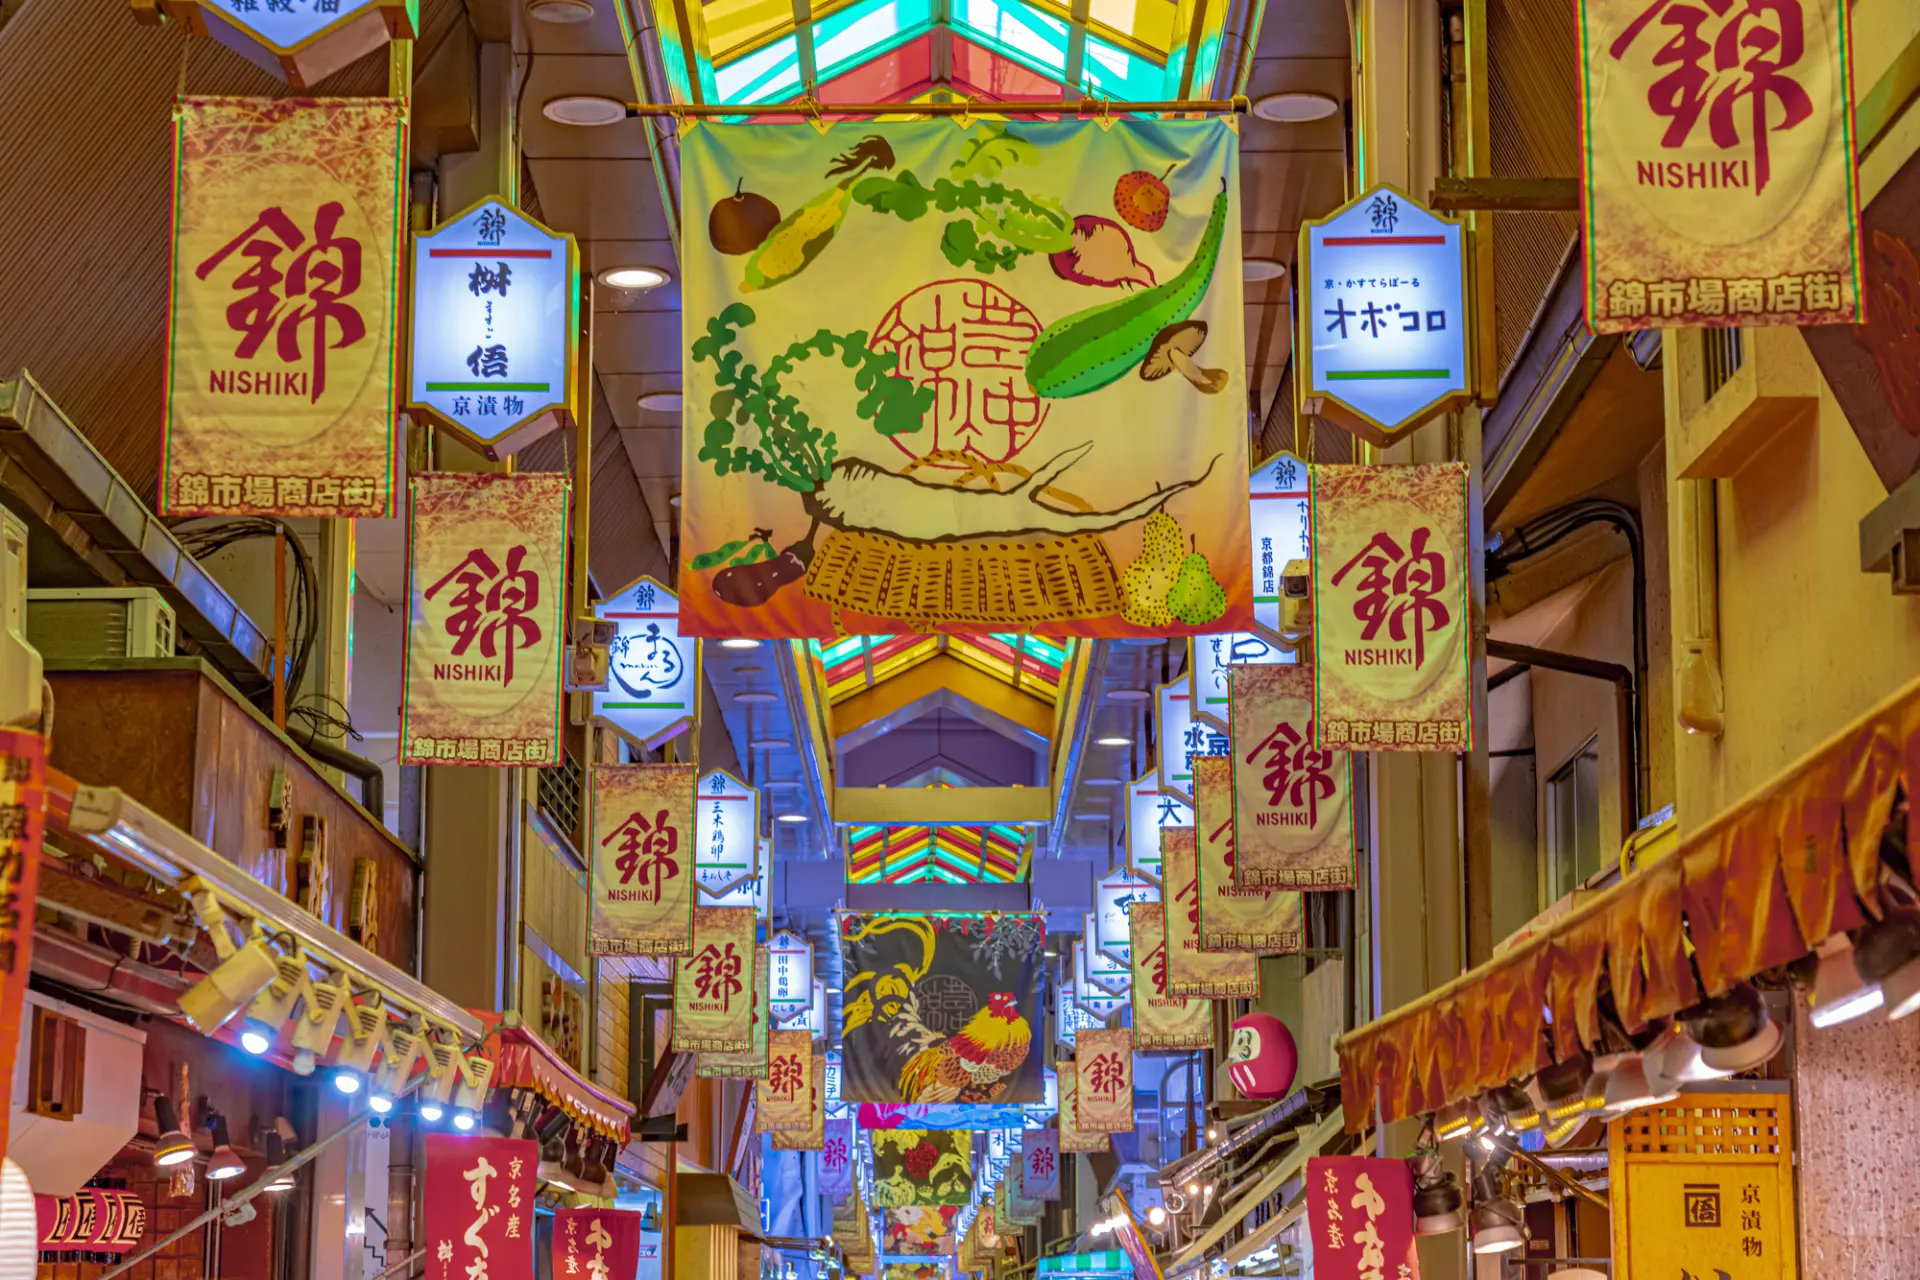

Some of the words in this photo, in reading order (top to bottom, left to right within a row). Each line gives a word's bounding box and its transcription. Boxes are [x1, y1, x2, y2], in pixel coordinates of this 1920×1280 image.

[1609, 0, 1813, 196] 錦
[1637, 160, 1749, 189] NISHIKI
[473, 207, 506, 246] 錦
[1365, 194, 1399, 233] 錦
[195, 201, 366, 404] 錦
[1608, 273, 1842, 319] 錦市場商店街
[1324, 298, 1447, 339] オボコロ
[210, 370, 307, 396] NISHIKI
[452, 395, 524, 416] 京漬物
[178, 475, 375, 508] 錦市場商店街
[1271, 459, 1297, 490] 錦
[1261, 537, 1274, 593] 京都錦店
[632, 584, 656, 611] 錦
[1331, 527, 1450, 671] 錦
[424, 544, 541, 688] 錦
[433, 663, 502, 682] NISHIKI
[1345, 648, 1413, 666] NISHIKI
[1326, 719, 1461, 745] 錦市場商店街
[412, 737, 548, 762] 錦市場商店街
[709, 775, 726, 794] 錦
[1246, 721, 1336, 830] 錦
[1256, 811, 1309, 827] NISHIKI
[601, 809, 679, 905] 錦
[1243, 867, 1348, 887] 錦市場商店街
[608, 889, 653, 901] NISHIKI
[593, 938, 687, 954] 錦市場商店街
[1207, 932, 1297, 949] 錦市場商店街
[684, 942, 743, 1014] 錦
[1174, 981, 1252, 995] 錦市場商店街
[689, 1002, 723, 1012] NISHIKI
[770, 1053, 804, 1104] 錦
[1083, 1052, 1125, 1103] 錦
[824, 1138, 848, 1173] 錦
[1027, 1146, 1055, 1181] 錦
[505, 1156, 524, 1239] 京名産
[1740, 1184, 1763, 1258] 京漬物
